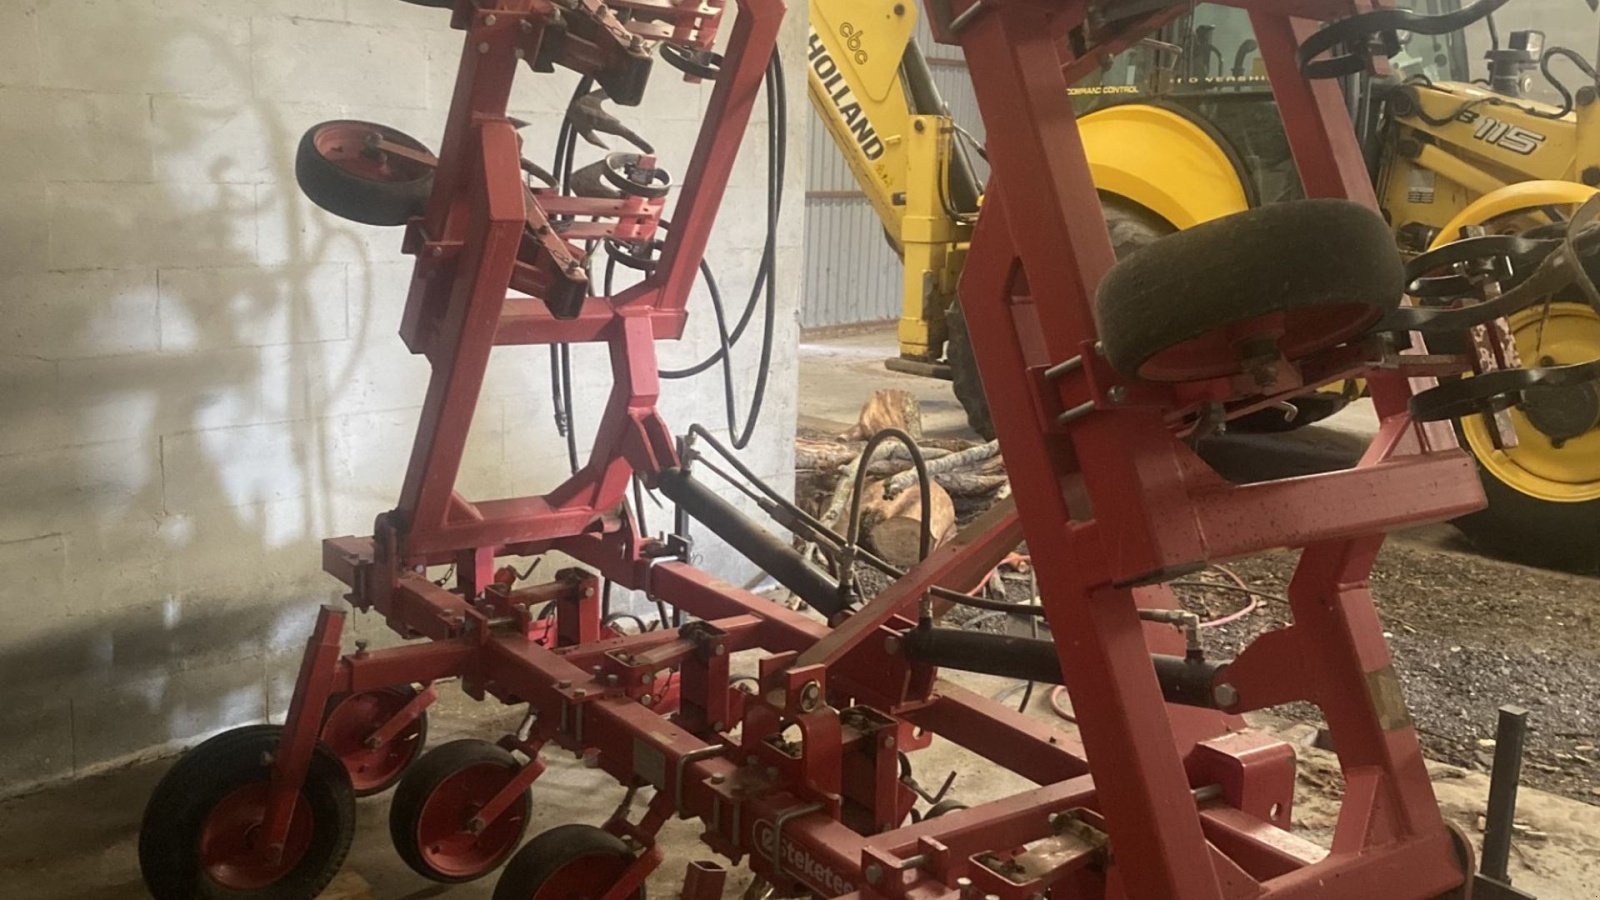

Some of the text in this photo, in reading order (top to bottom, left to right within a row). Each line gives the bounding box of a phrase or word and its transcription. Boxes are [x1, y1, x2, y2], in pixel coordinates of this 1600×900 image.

[839, 22, 868, 65] cbc
[808, 33, 885, 161] HOLLAND
[1102, 86, 1140, 94] CONTROL
